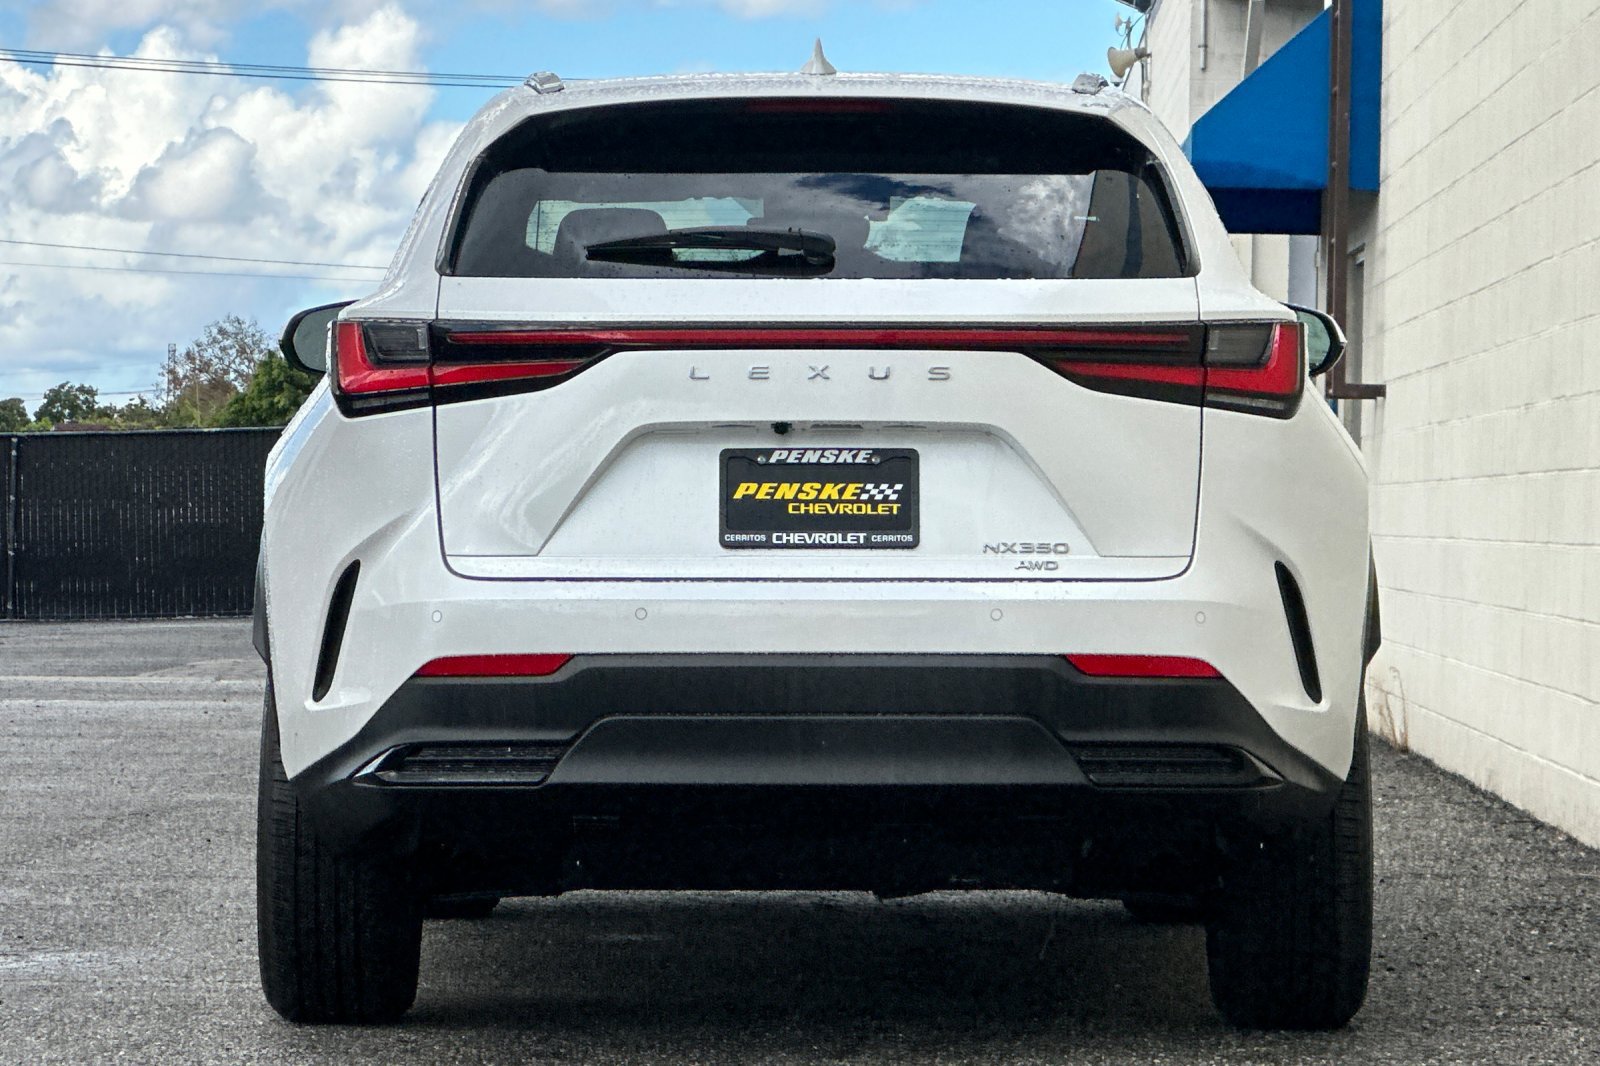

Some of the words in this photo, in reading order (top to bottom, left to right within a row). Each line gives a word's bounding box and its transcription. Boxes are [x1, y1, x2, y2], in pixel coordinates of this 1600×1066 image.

[689, 365, 951, 381] LEXUS
[769, 450, 872, 464] PENSKE
[733, 483, 862, 500] PENSKE
[788, 502, 901, 515] CHEVROLET
[724, 534, 767, 542] CERRITOS
[772, 532, 867, 544] CHEVROLET
[871, 534, 913, 542] CERRITOS
[983, 542, 1070, 555] NX350
[1014, 560, 1059, 571] AWD
